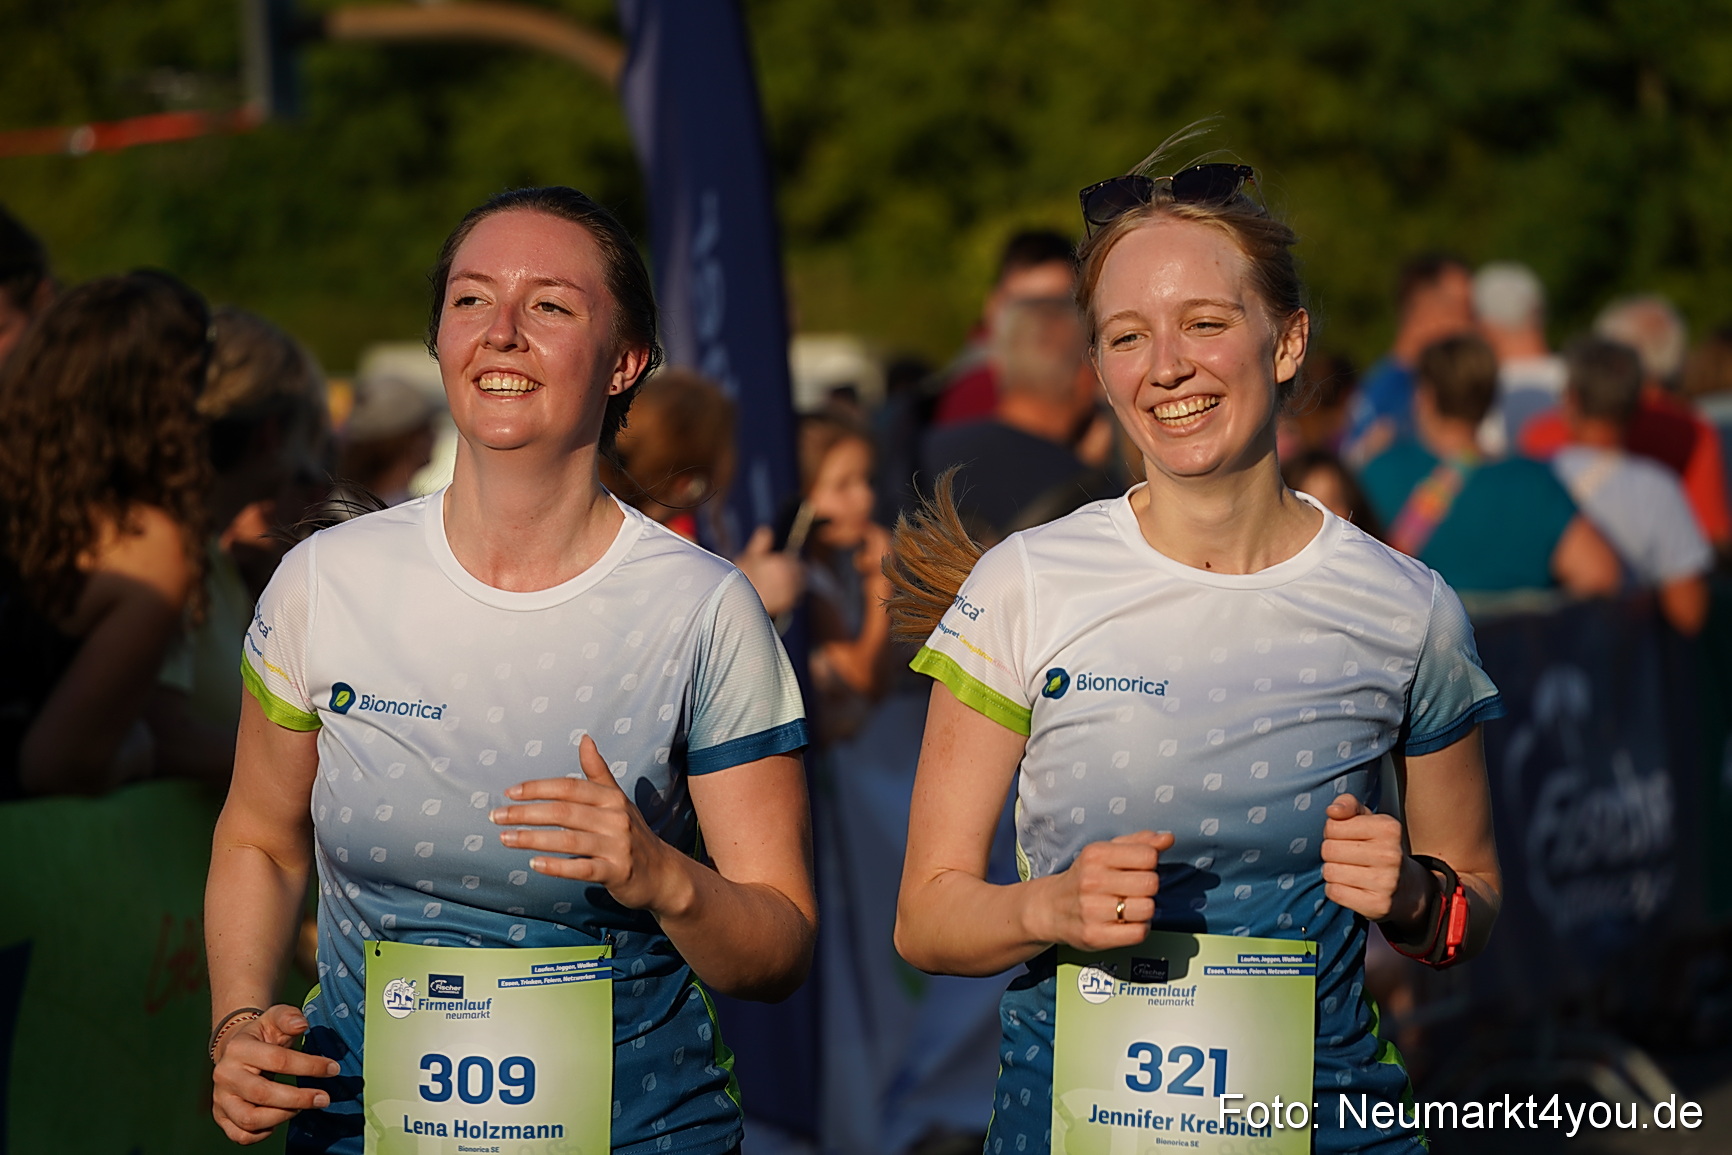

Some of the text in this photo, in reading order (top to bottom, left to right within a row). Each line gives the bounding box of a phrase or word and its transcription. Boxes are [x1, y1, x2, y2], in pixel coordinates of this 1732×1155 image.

[1119, 983, 1198, 998] Firmenlauf
[418, 998, 492, 1011] Firmenlauf
[1147, 998, 1195, 1007] neumarkt
[446, 1011, 490, 1020] neumarkt
[1125, 1041, 1228, 1098] 321
[419, 1053, 536, 1105] 309
[1088, 1104, 1174, 1131] Jennifer
[403, 1114, 564, 1139] Lena Holzmann
[458, 1145, 490, 1153] Bionorica
[1155, 1137, 1200, 1148] Bionorica SE
